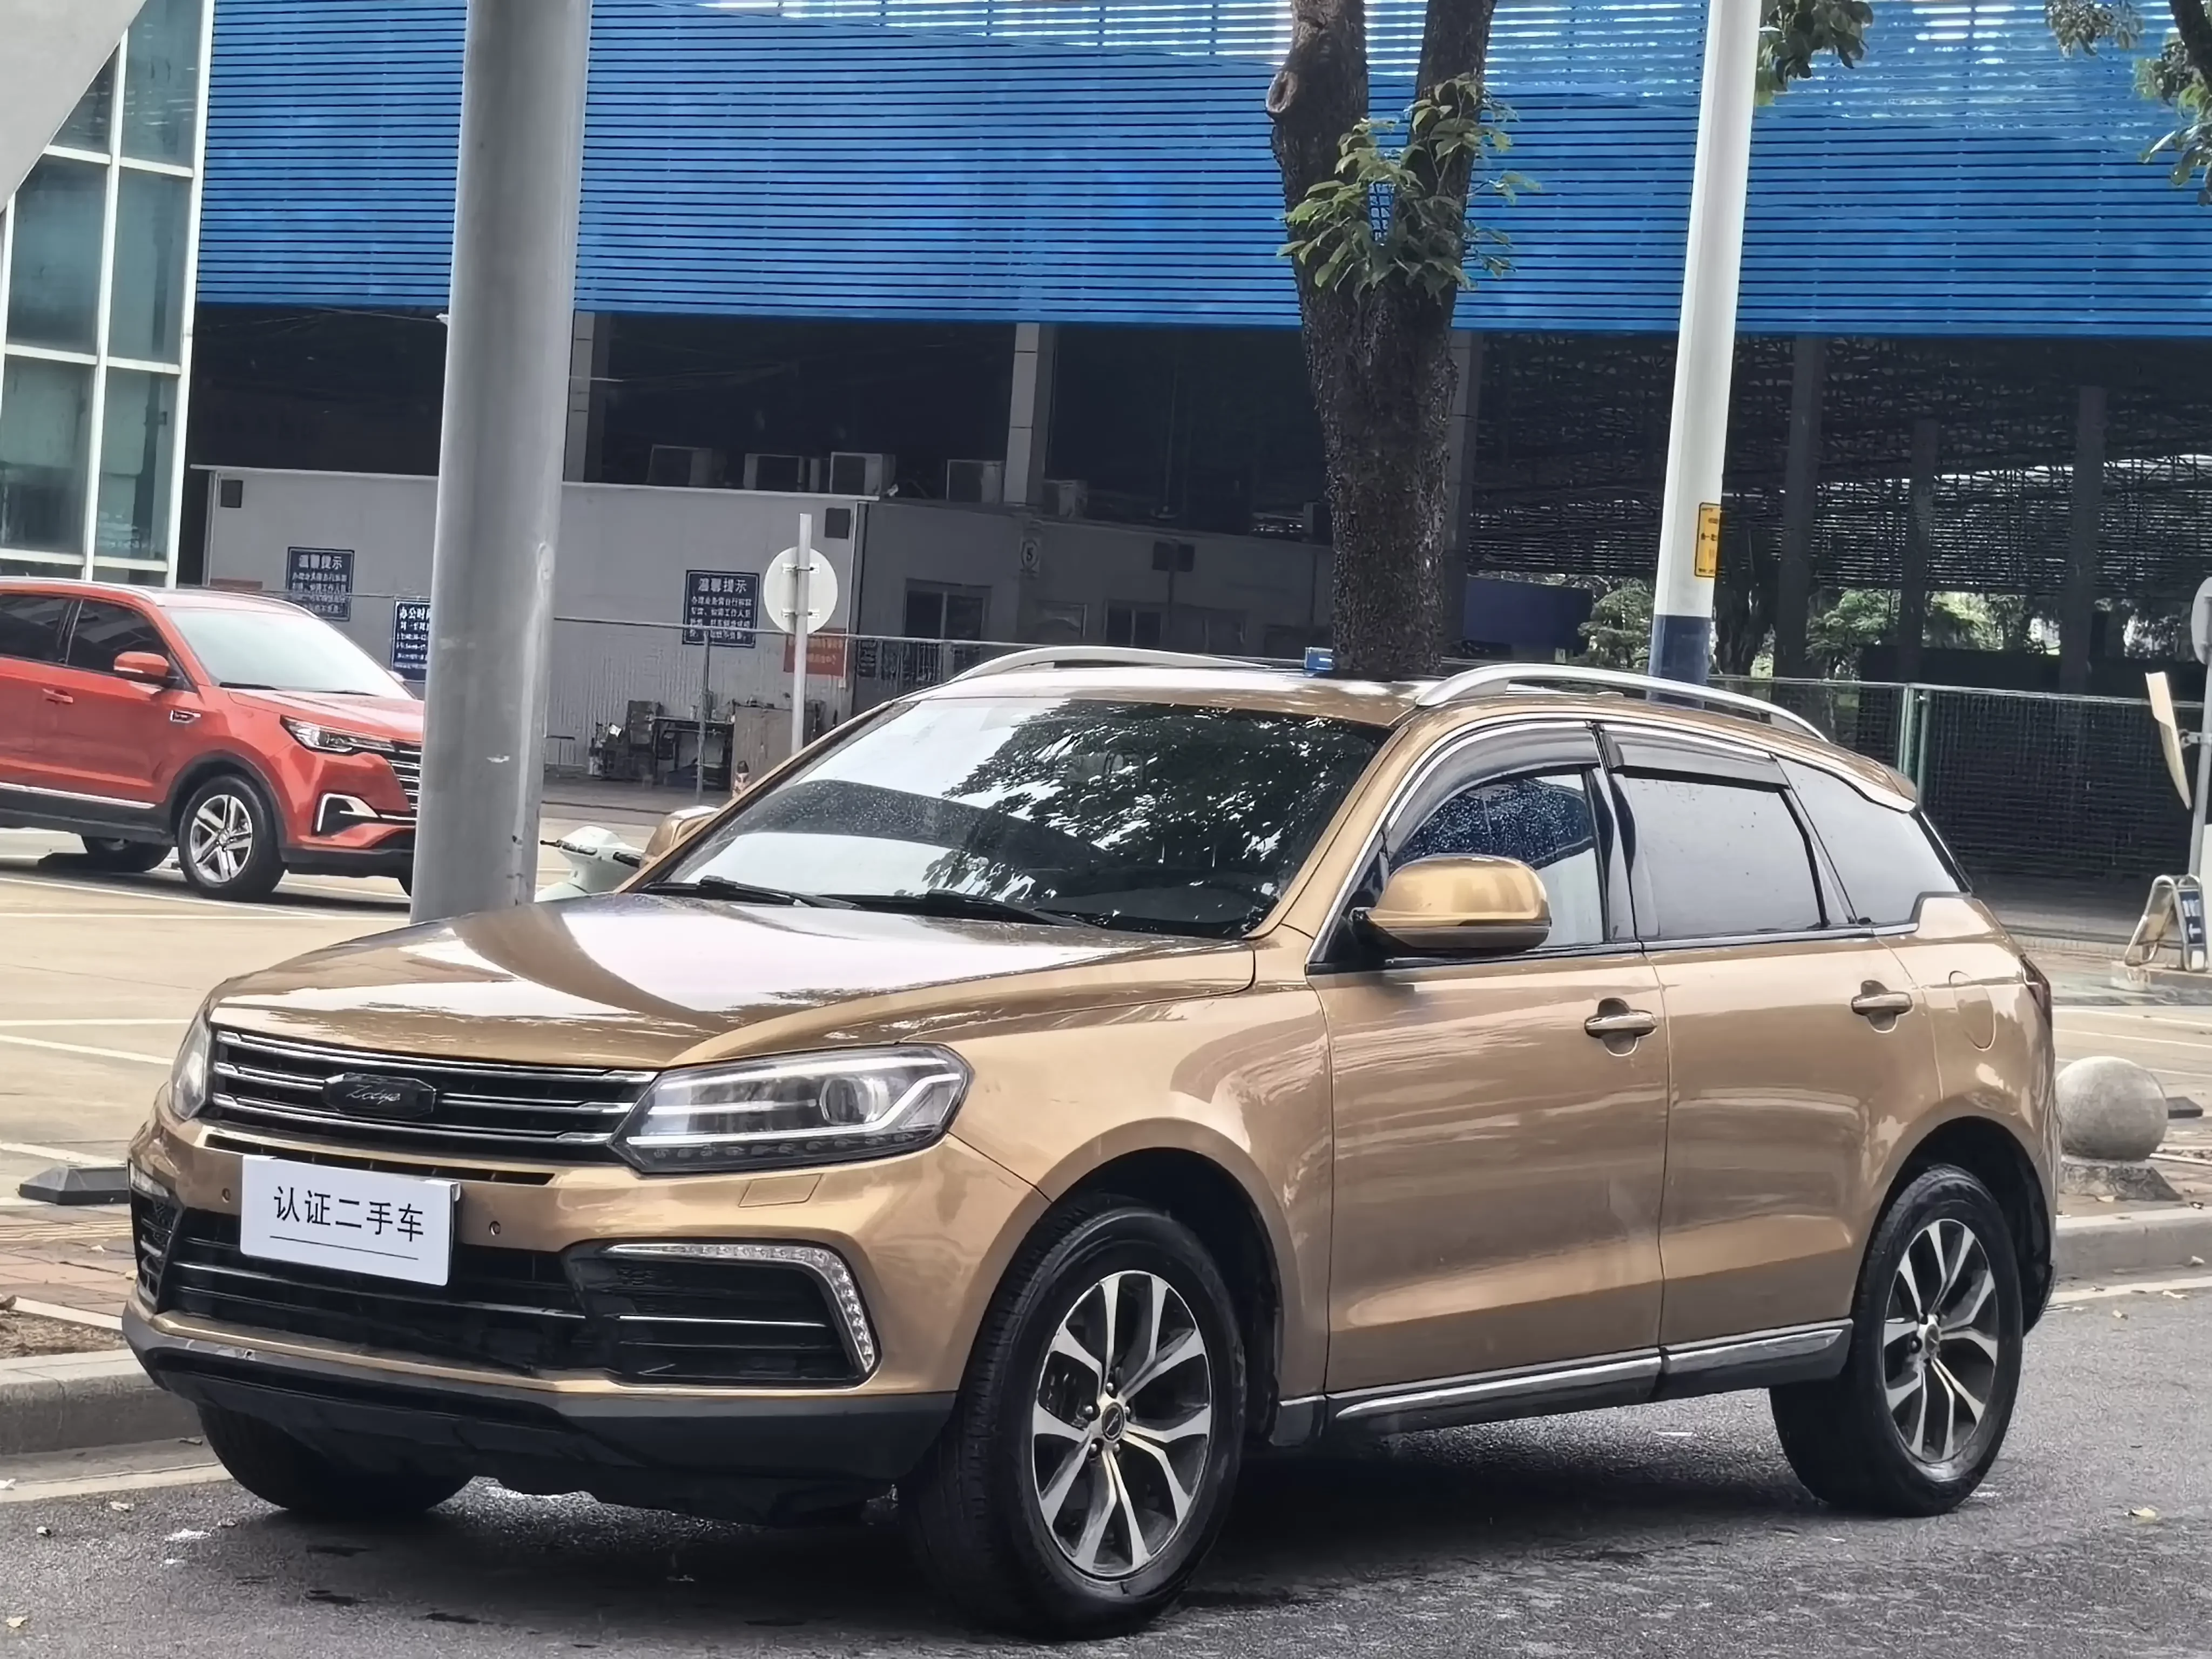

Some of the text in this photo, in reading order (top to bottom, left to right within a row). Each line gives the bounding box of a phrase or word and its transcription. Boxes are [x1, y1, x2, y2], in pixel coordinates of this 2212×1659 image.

[273, 1185, 424, 1243] 认证二手车
